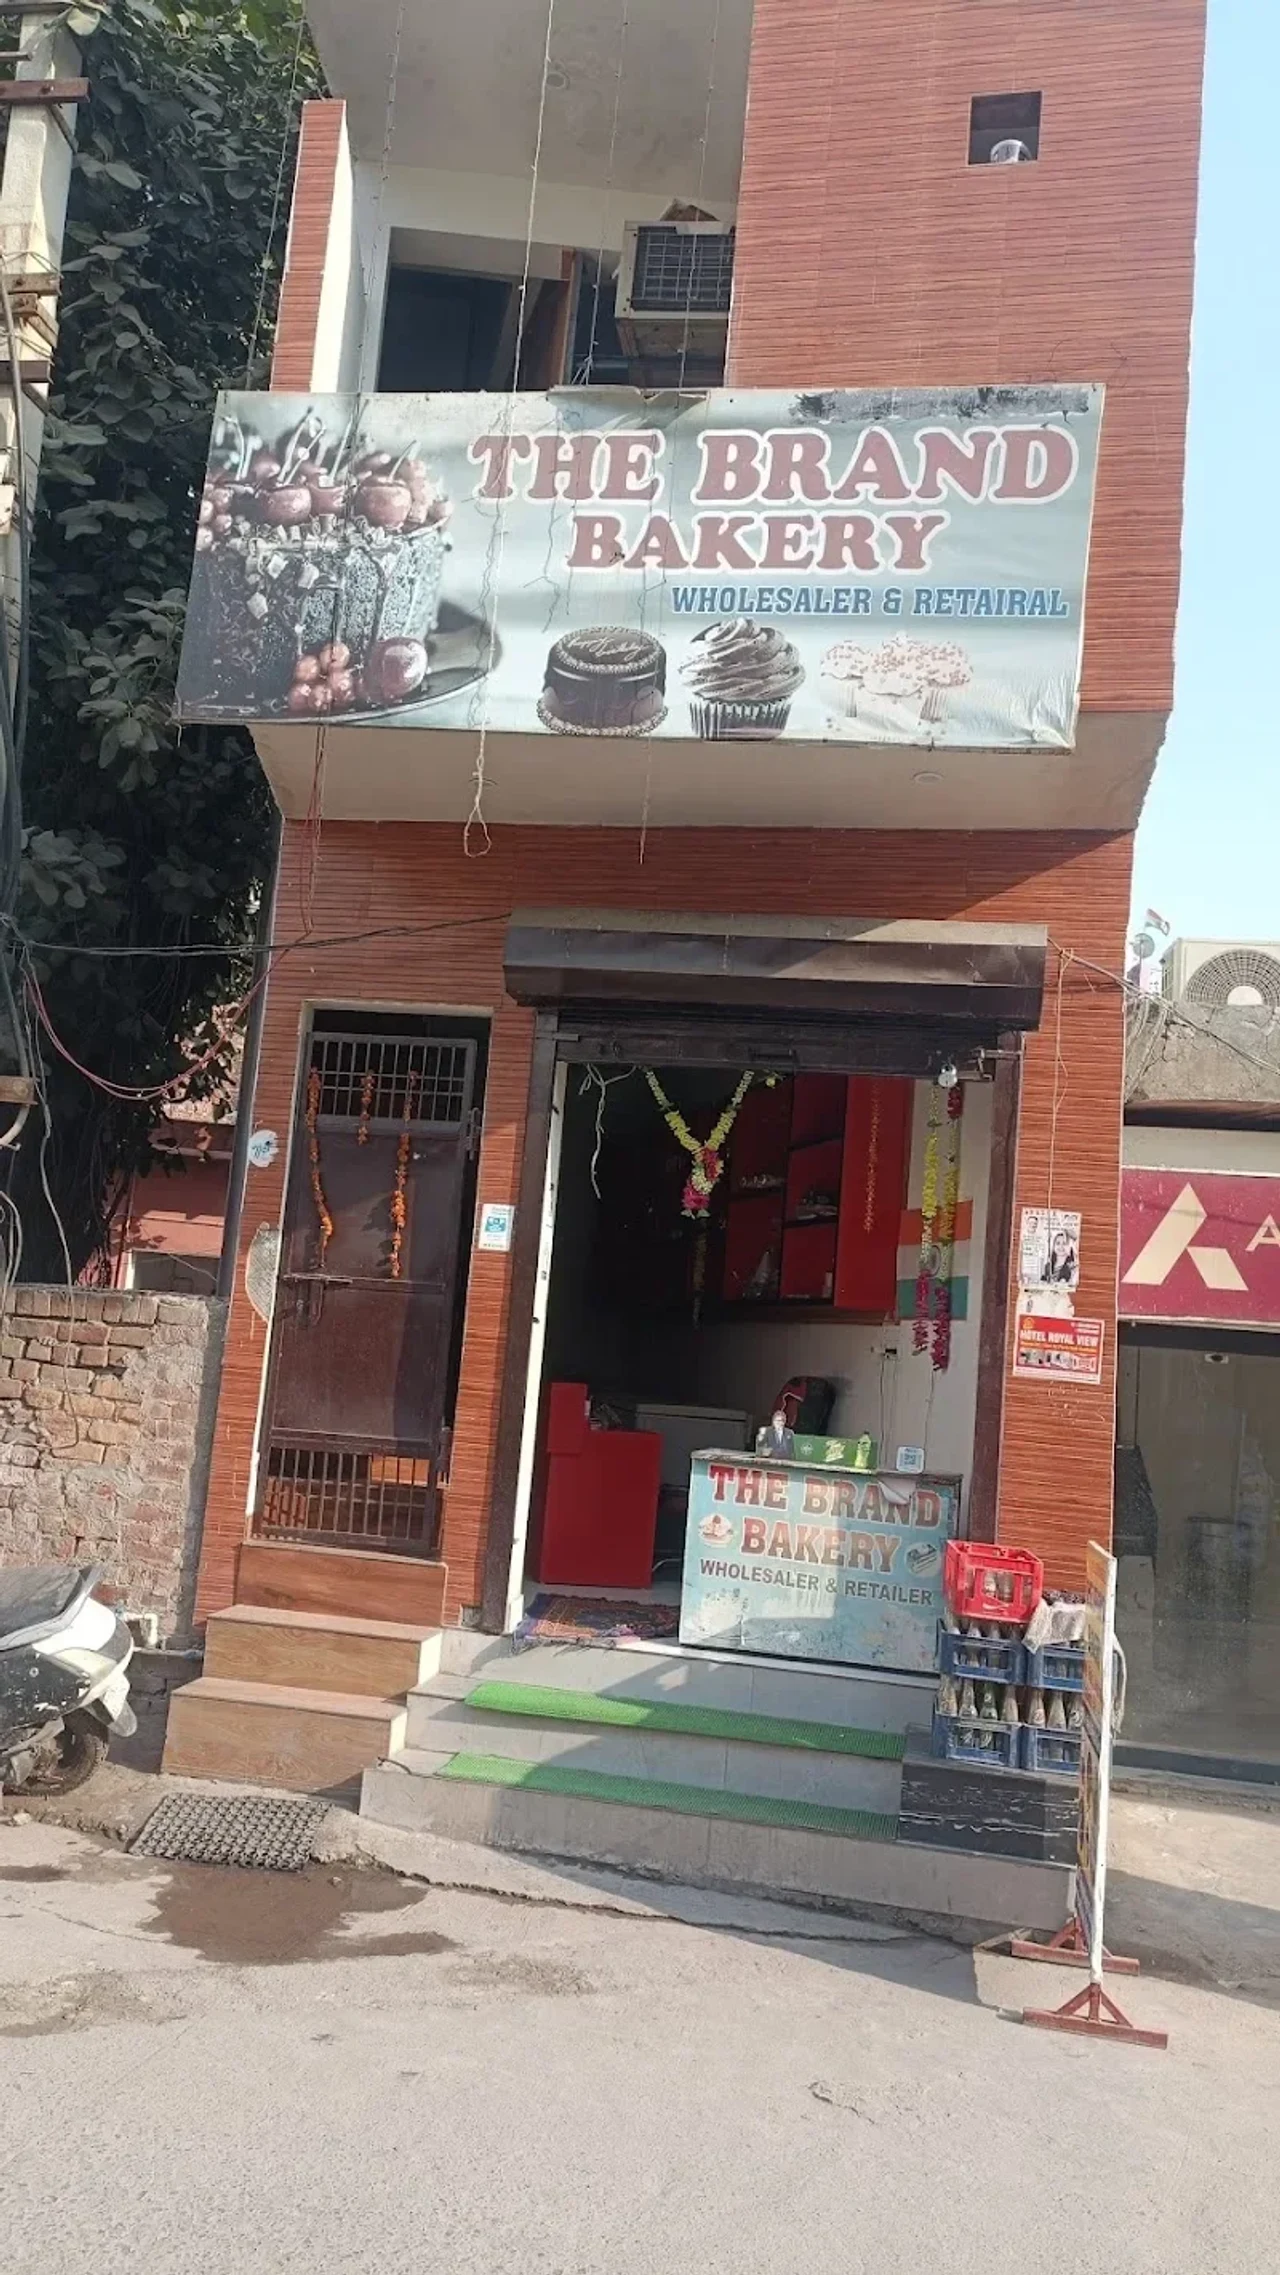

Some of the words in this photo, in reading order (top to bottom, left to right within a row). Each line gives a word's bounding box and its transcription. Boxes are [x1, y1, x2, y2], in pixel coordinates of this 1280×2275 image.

[469, 430, 664, 503] THE
[697, 427, 1076, 506] BRAND
[566, 511, 947, 573] BAKERY
[672, 585, 872, 616] WHOLESALER
[883, 587, 903, 615] &
[911, 586, 1069, 618] RETAIRAL
[1048, 1331, 1075, 1345] ROYAL
[1077, 1334, 1099, 1347] VIEW
[708, 1464, 790, 1511] THE
[802, 1475, 942, 1528] BRAND
[740, 1517, 901, 1575] BAKERY
[700, 1559, 819, 1591] WHOLESALER
[826, 1578, 837, 1593] &
[845, 1579, 932, 1605] RETAILER
